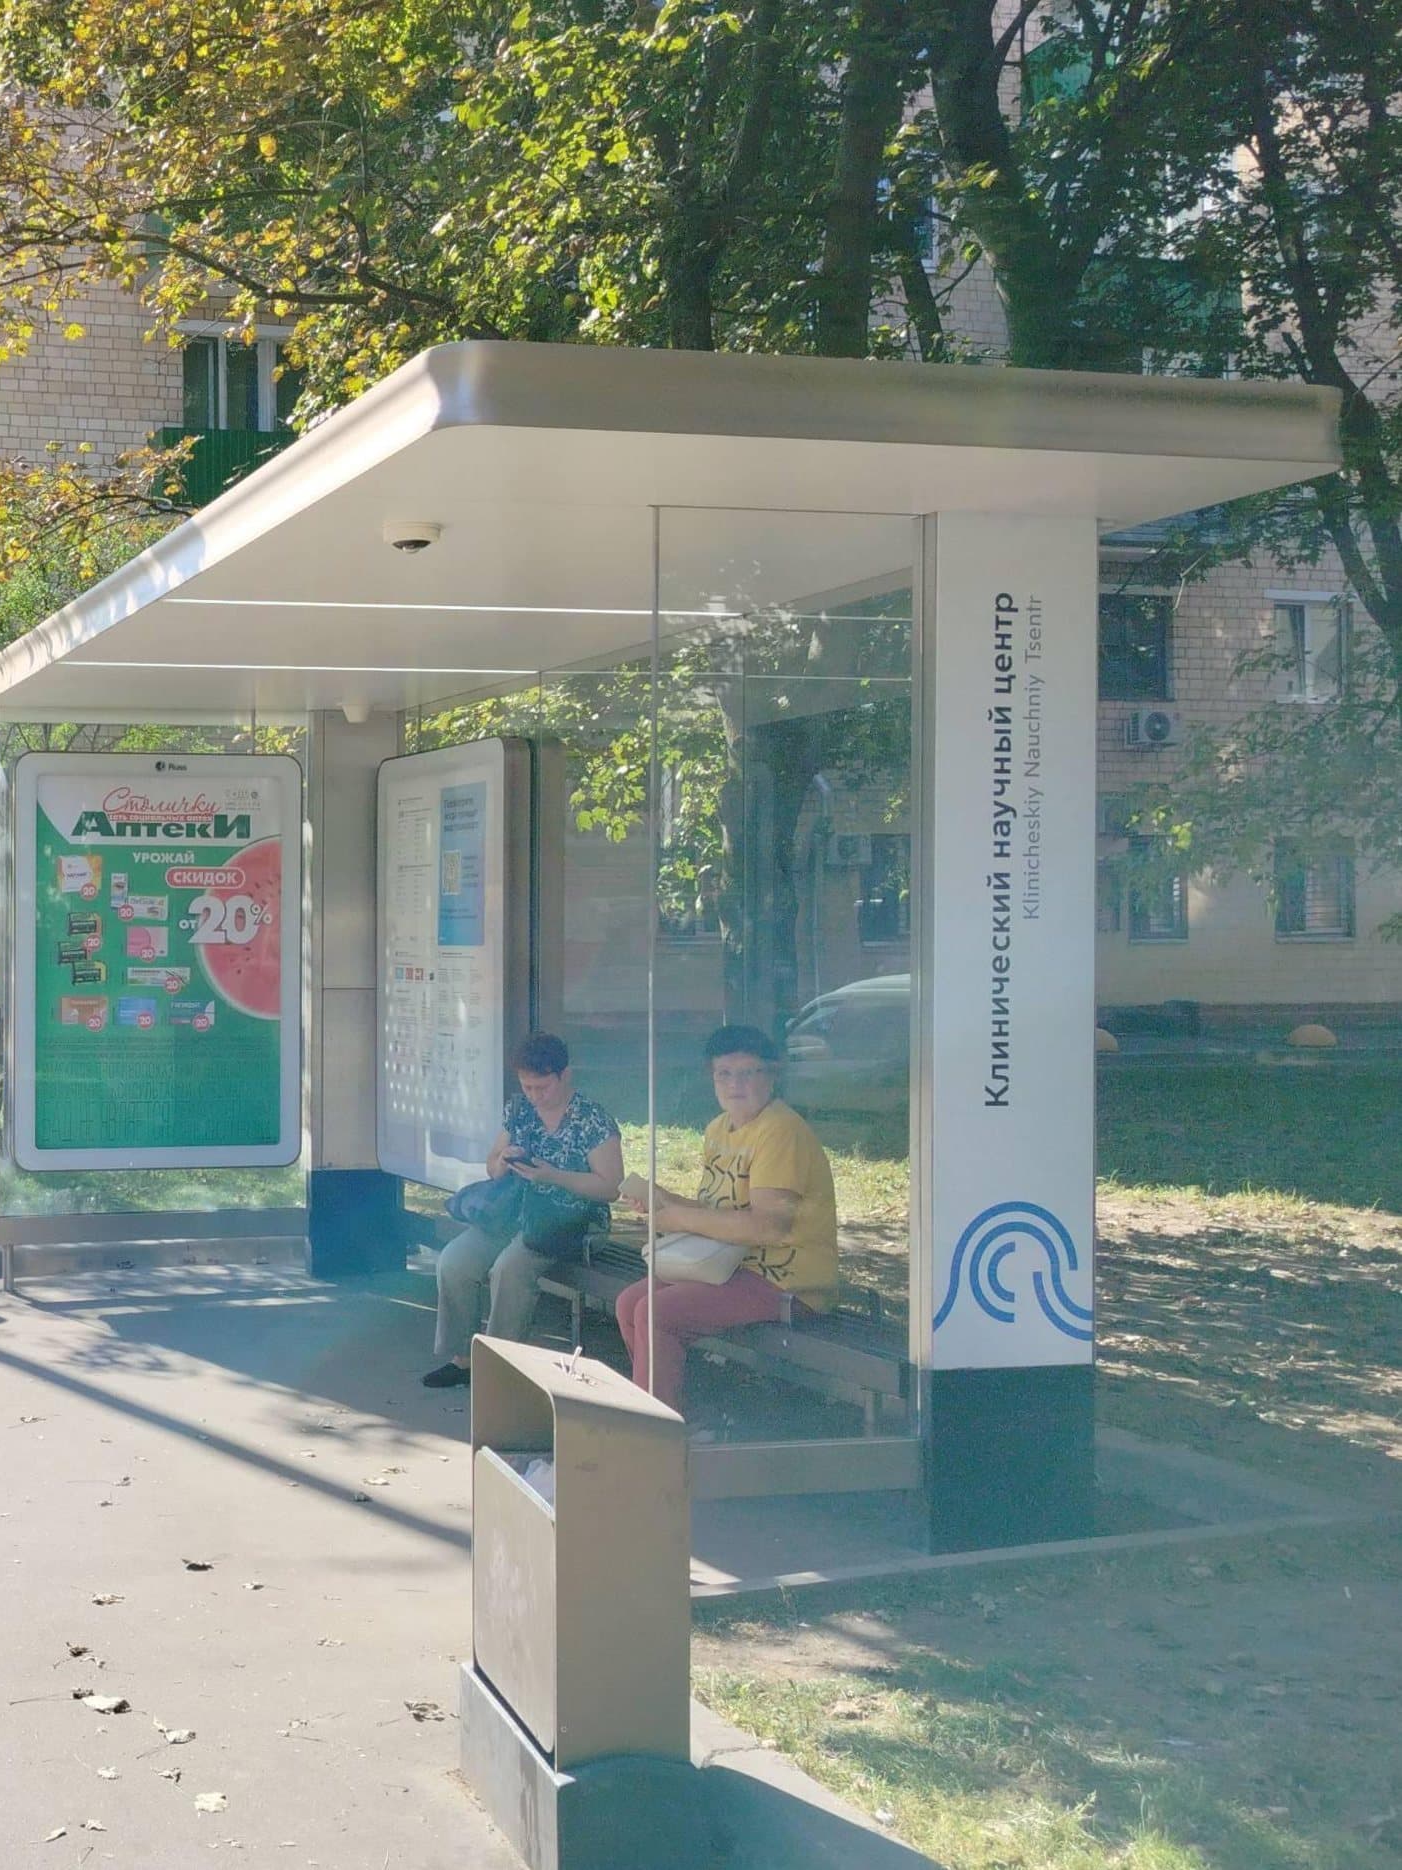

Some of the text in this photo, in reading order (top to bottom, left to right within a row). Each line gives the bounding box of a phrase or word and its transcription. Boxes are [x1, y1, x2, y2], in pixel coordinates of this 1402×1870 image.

[1022, 595, 1045, 919] Klinicheskiy Nauchniy Tsentr
[103, 787, 221, 814] Столички
[133, 851, 195, 864] УРОЖАЙ
[985, 592, 1018, 1107] Клинический научный центр
[173, 872, 237, 885] СКИДОК
